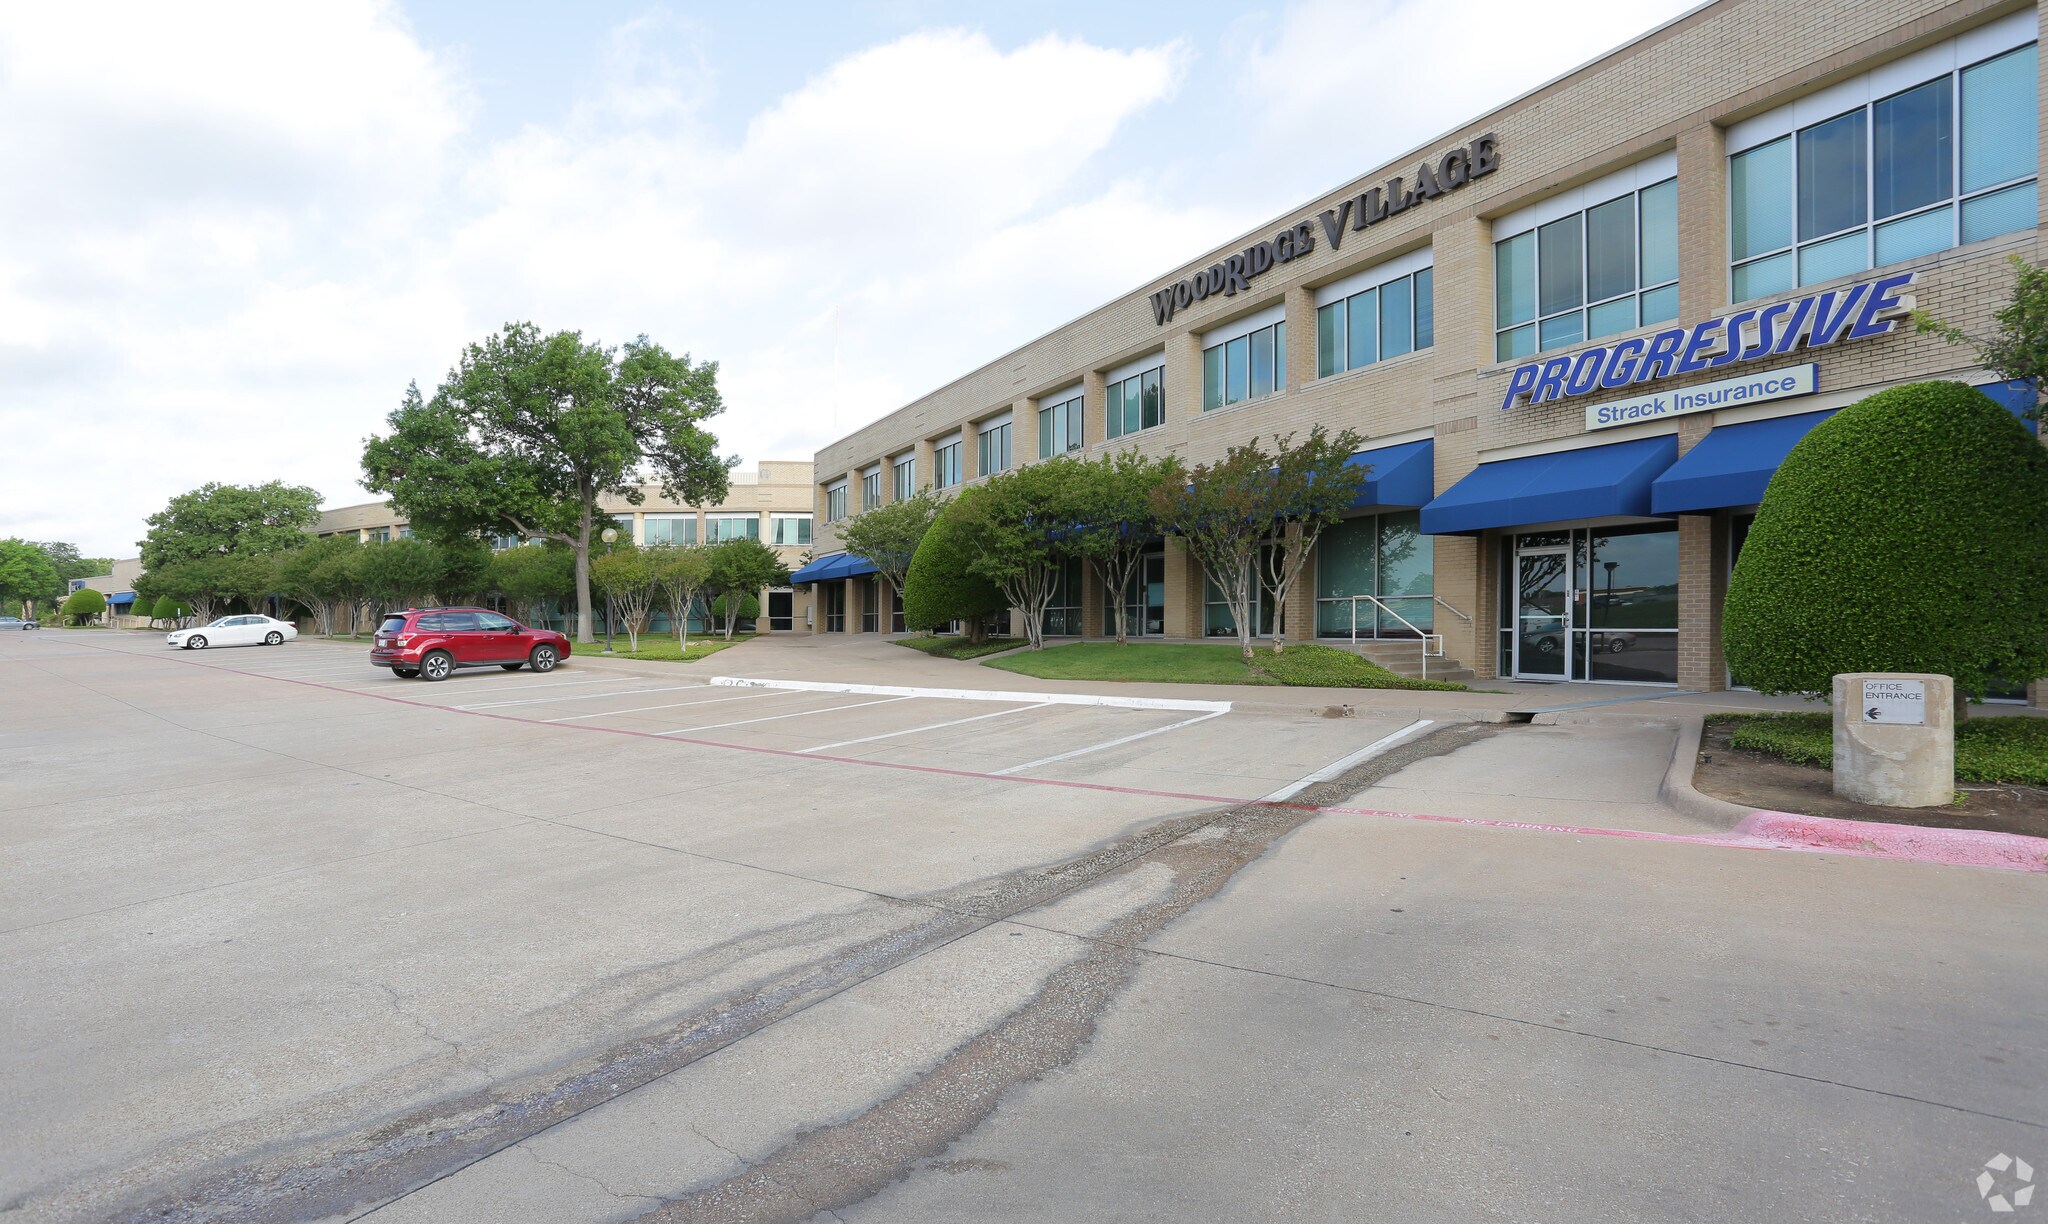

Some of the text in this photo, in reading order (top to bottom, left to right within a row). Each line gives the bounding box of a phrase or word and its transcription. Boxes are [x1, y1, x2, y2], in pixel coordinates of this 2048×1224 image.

[1149, 132, 1501, 326] WOODRIDGE VILLAGE
[1502, 272, 1919, 410] PROGRESSIVE
[1597, 376, 1796, 424] Strack Insurance
[1865, 683, 1903, 691] OFFICE
[1865, 692, 1922, 700] ENTRANCE
[1496, 821, 1581, 833] PARKING
